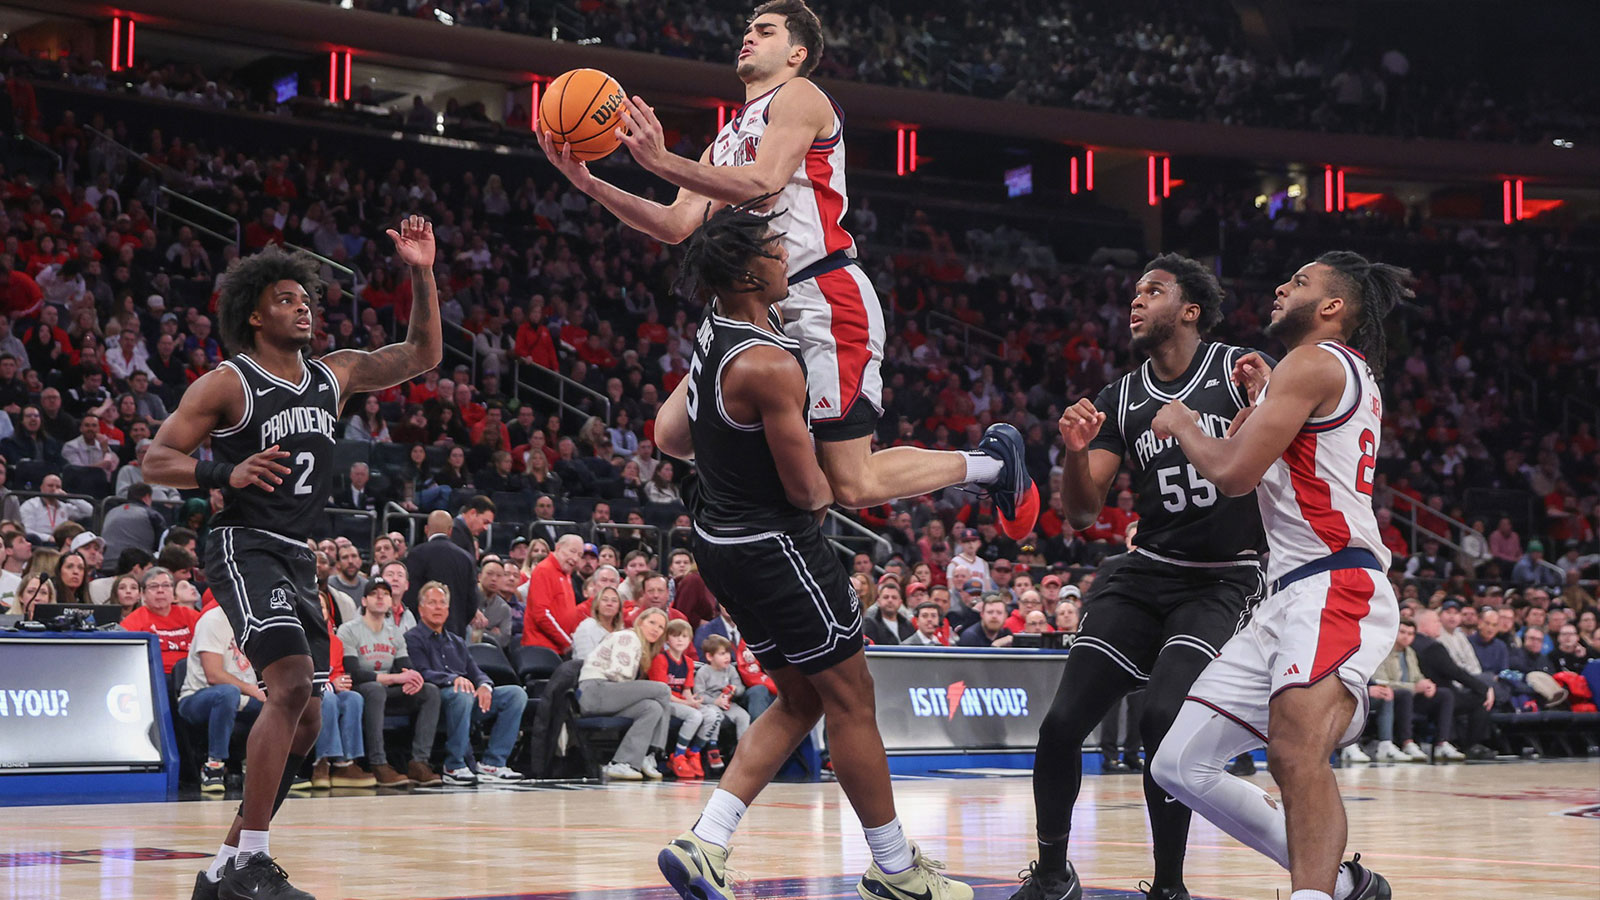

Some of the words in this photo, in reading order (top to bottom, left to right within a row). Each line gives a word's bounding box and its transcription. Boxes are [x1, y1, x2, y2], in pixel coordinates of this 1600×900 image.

[686, 350, 703, 422] 5
[261, 406, 338, 451] PROVIDENCE
[294, 451, 316, 495] 2
[1157, 463, 1218, 513] 55
[8, 689, 70, 717] YOU?
[106, 684, 142, 723] G
[977, 687, 1029, 717] YOU?
